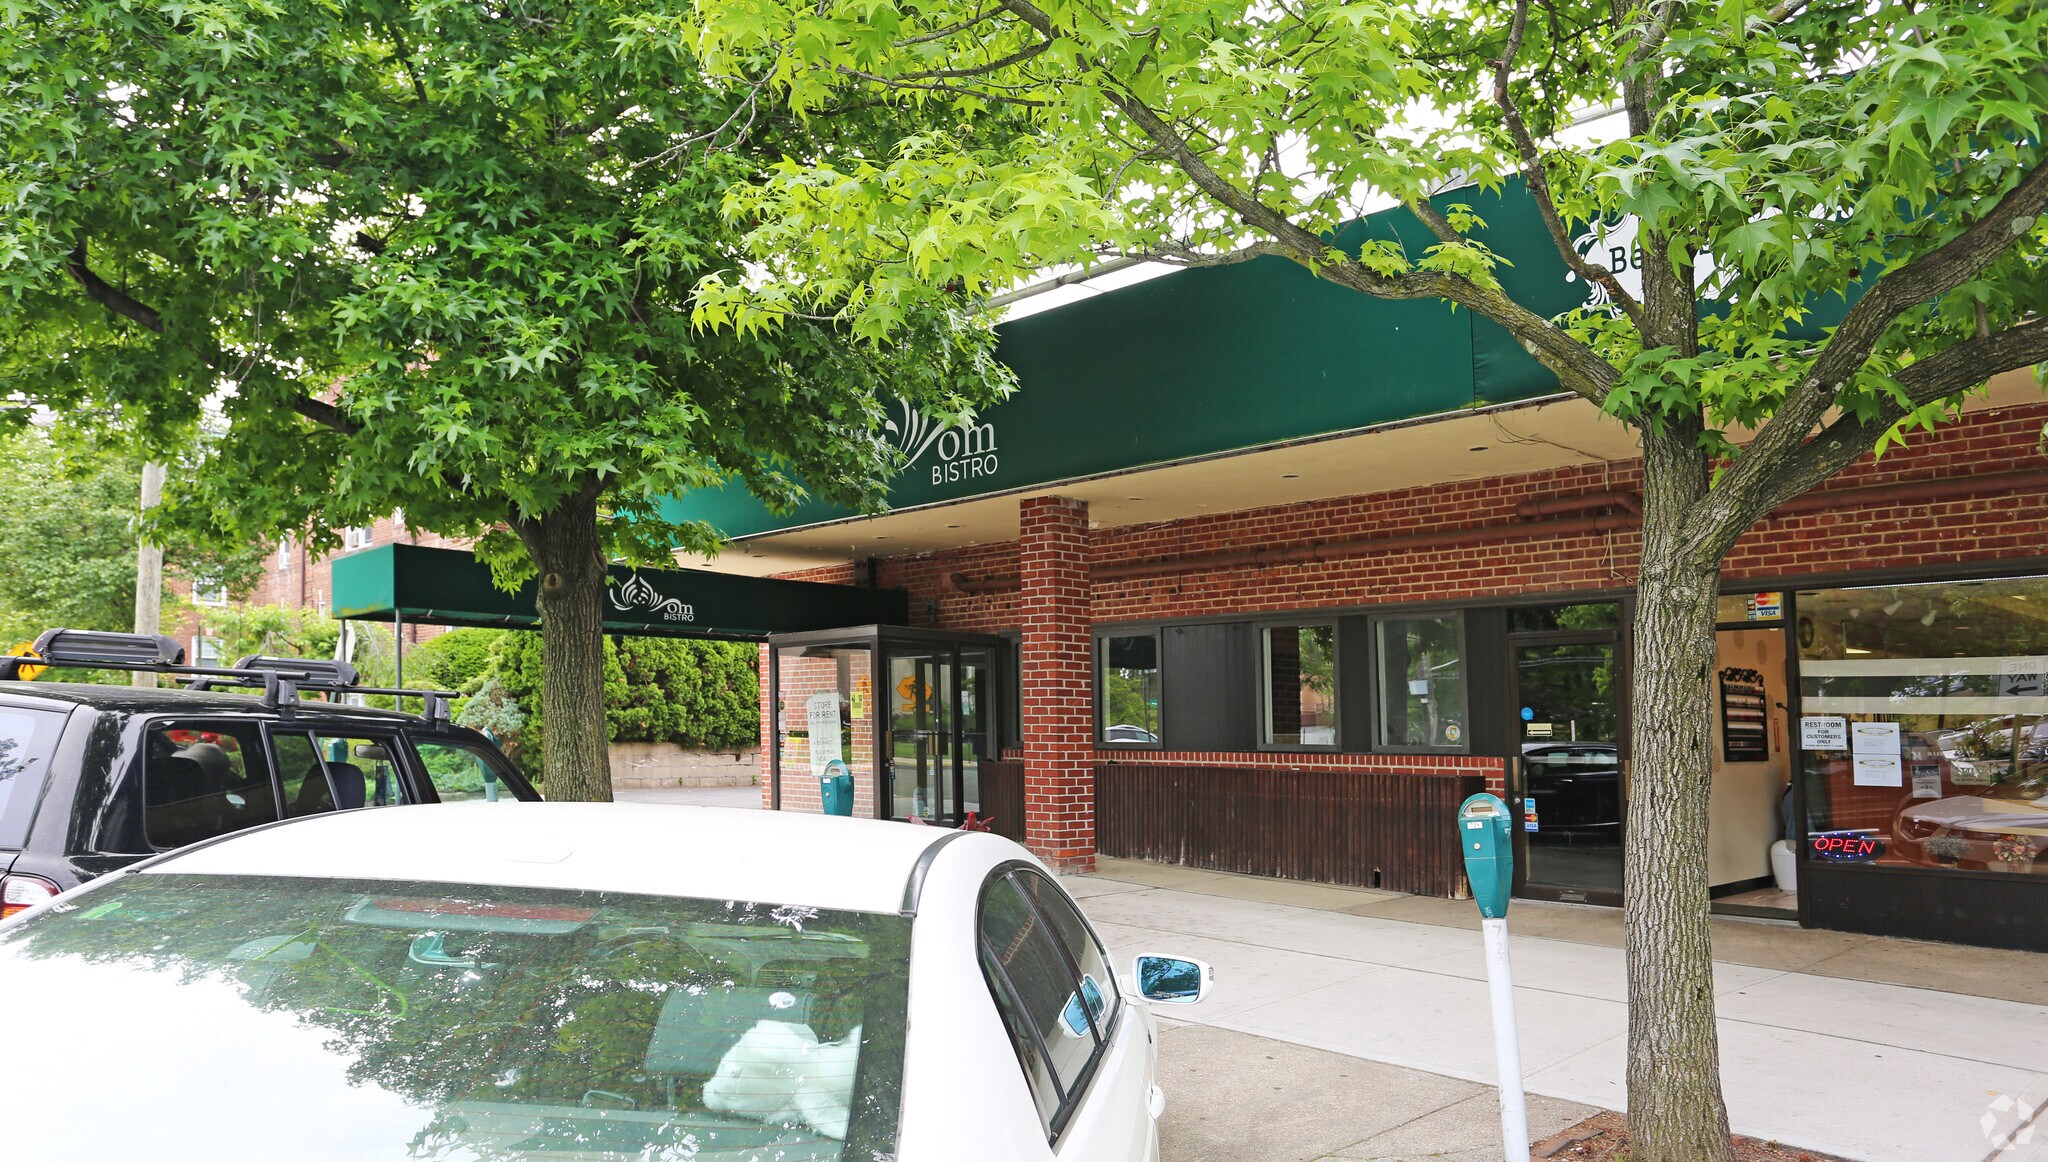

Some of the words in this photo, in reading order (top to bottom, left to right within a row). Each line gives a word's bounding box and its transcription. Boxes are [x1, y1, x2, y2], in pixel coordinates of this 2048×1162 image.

[938, 421, 998, 460] om
[932, 454, 998, 485] BISTRO
[667, 602, 694, 615] om
[664, 612, 694, 622] BISTRO
[813, 701, 831, 710] STORE
[809, 711, 820, 719] FOR
[821, 710, 836, 719] RENT
[1814, 837, 1876, 854] OPEN
